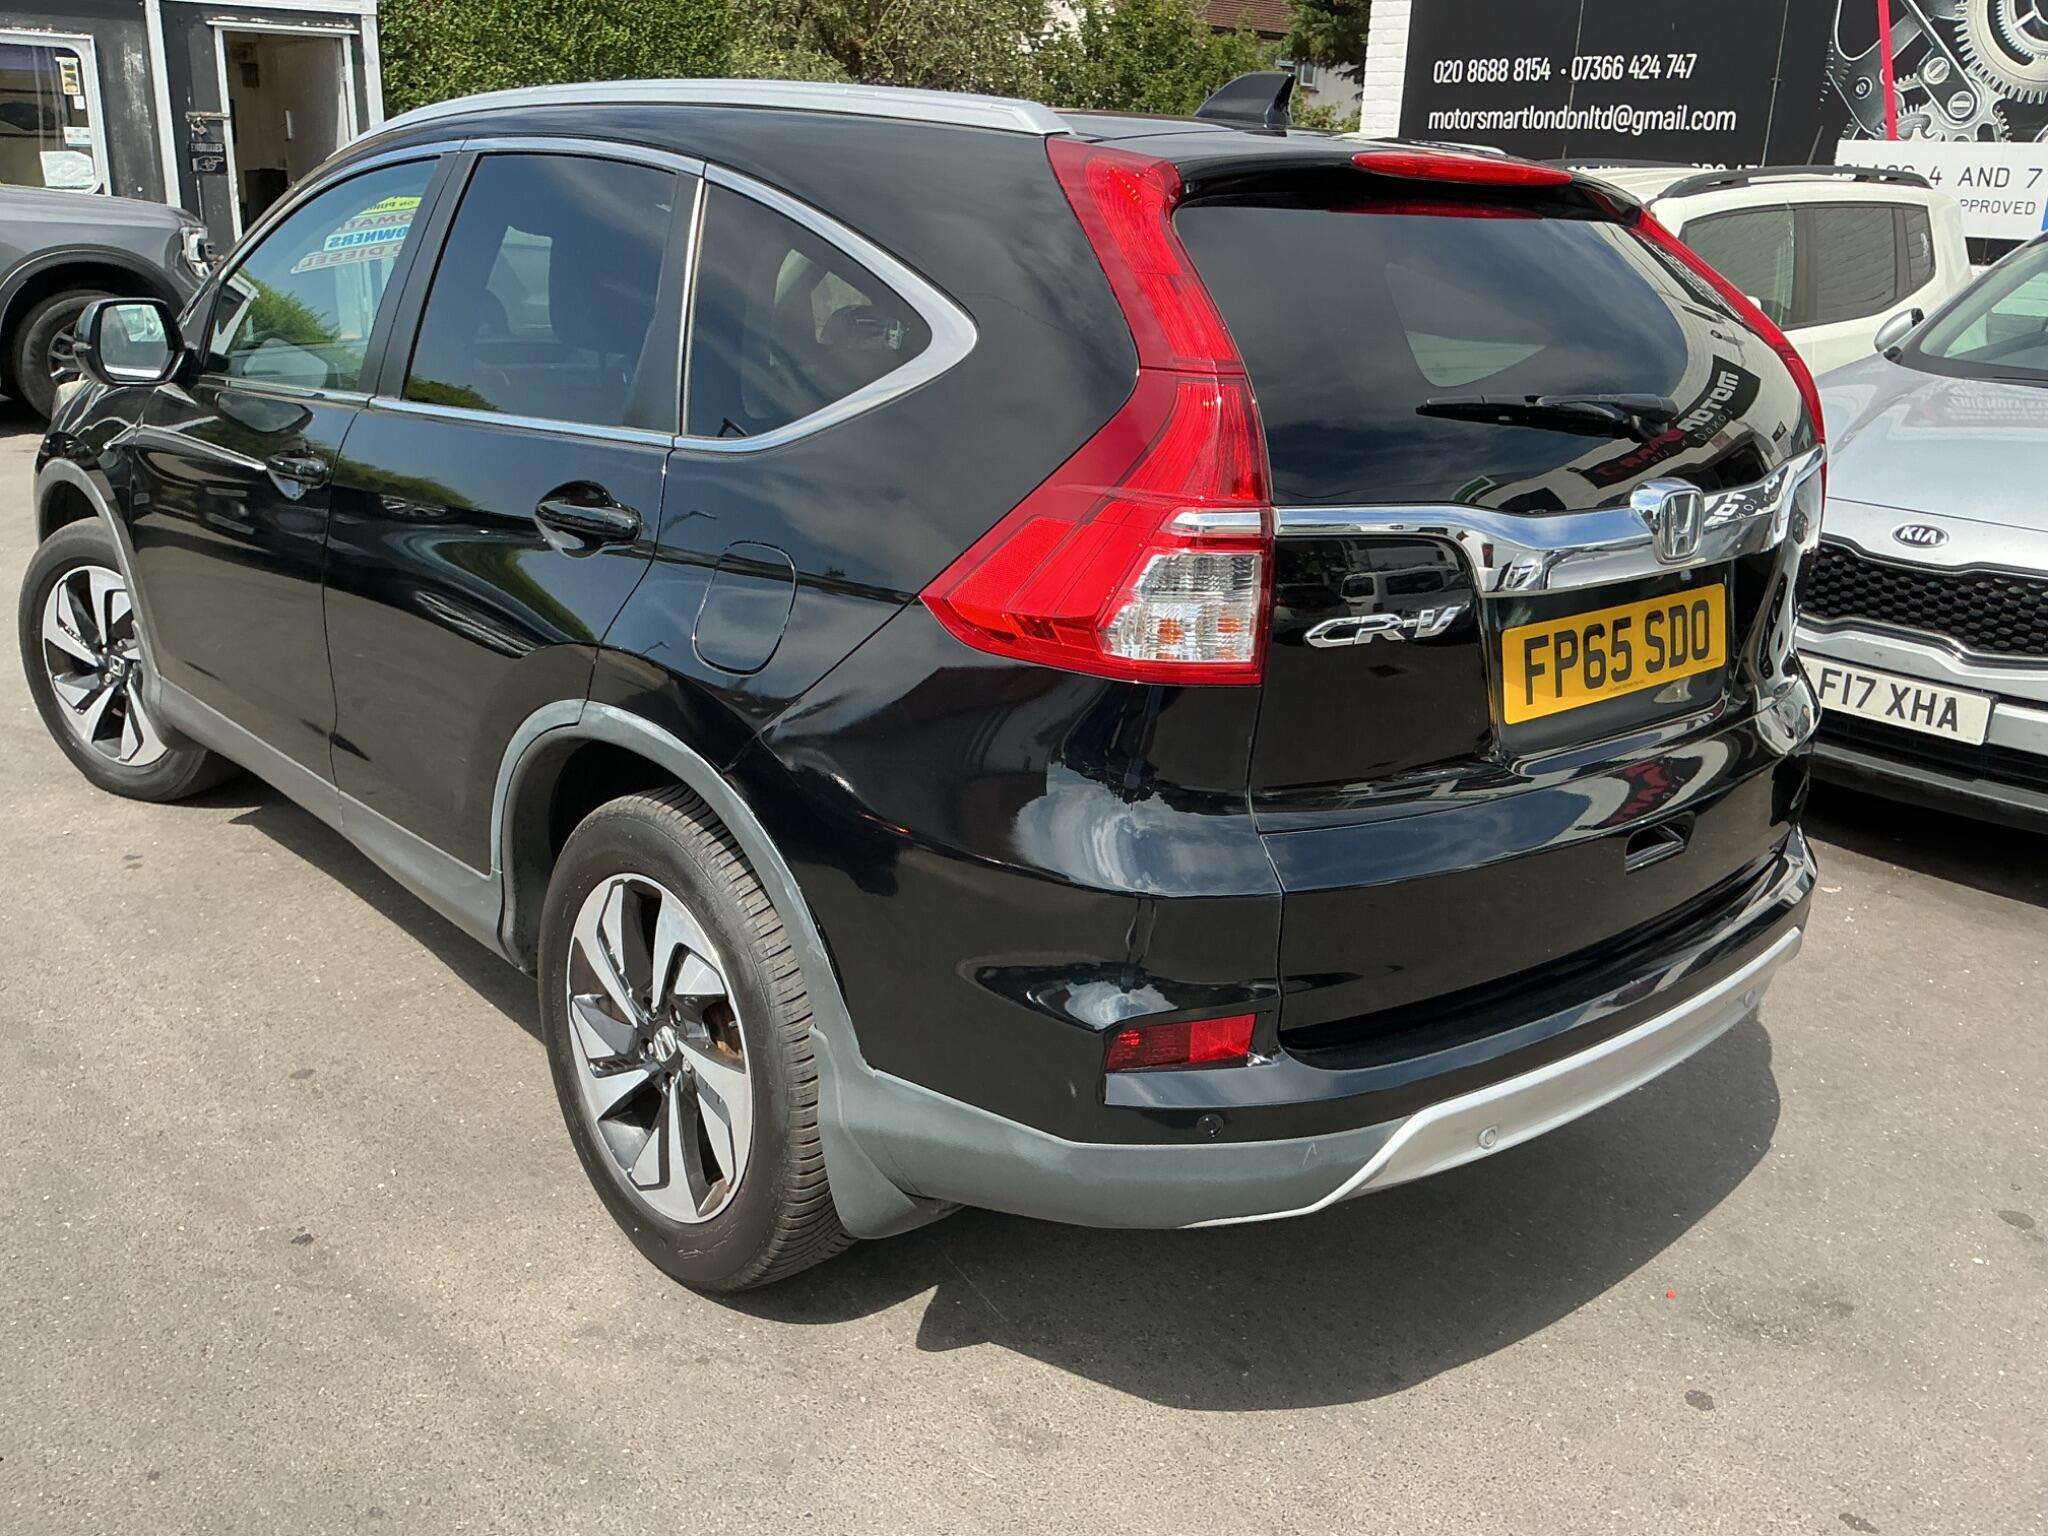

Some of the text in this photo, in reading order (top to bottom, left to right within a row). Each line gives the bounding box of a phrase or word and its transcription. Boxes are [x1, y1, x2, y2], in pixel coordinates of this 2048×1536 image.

[1432, 53, 1698, 83] 020 8688 8154 07366 424 747
[1428, 104, 1736, 135] motorsmartlondonltd@gmail.com
[1928, 165, 1943, 186] 4
[1957, 166, 2010, 188] AND
[2025, 168, 2043, 189] 7
[1960, 199, 2036, 216] PPROVED
[1899, 526, 1938, 545] KIA
[1303, 605, 1463, 648] CR-V
[1524, 598, 1711, 706] FP65 SDO
[1884, 683, 1958, 733] XHA
